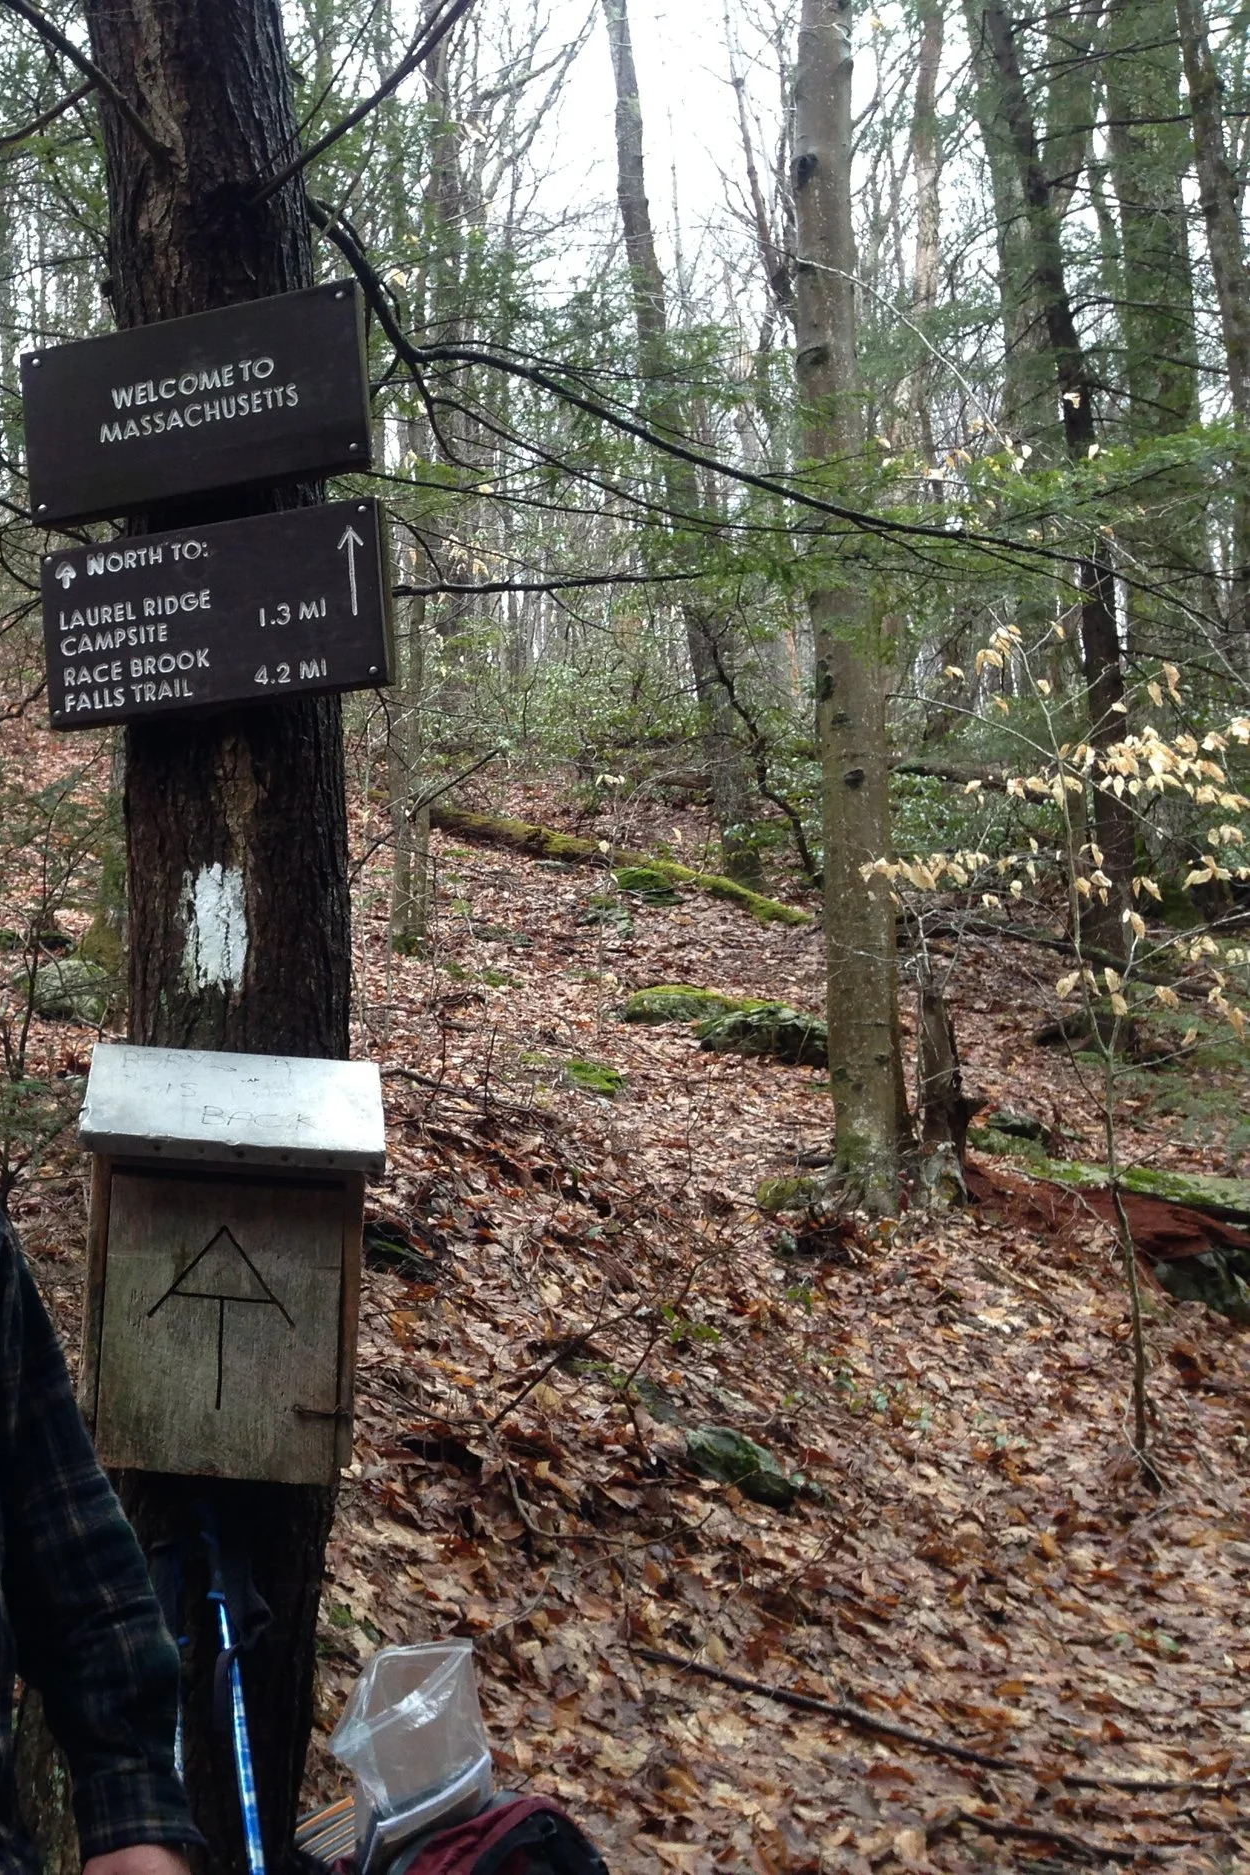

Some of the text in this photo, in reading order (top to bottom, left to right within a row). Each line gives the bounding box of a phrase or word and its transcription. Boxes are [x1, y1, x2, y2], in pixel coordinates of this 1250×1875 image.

[111, 356, 275, 410] WELCOME TO
[99, 383, 299, 444] MASSACHUSETTS
[86, 540, 209, 576] NORTH TO:
[59, 589, 212, 631] LAUREL RIDGE
[258, 597, 327, 628] 1.3 MI
[60, 623, 168, 657] CAMPSITE
[63, 648, 210, 687] RACE BROOK
[254, 658, 328, 685] 4.2 MI
[64, 678, 193, 713] FALLS TRAIL
[201, 1105, 317, 1131] BACK
